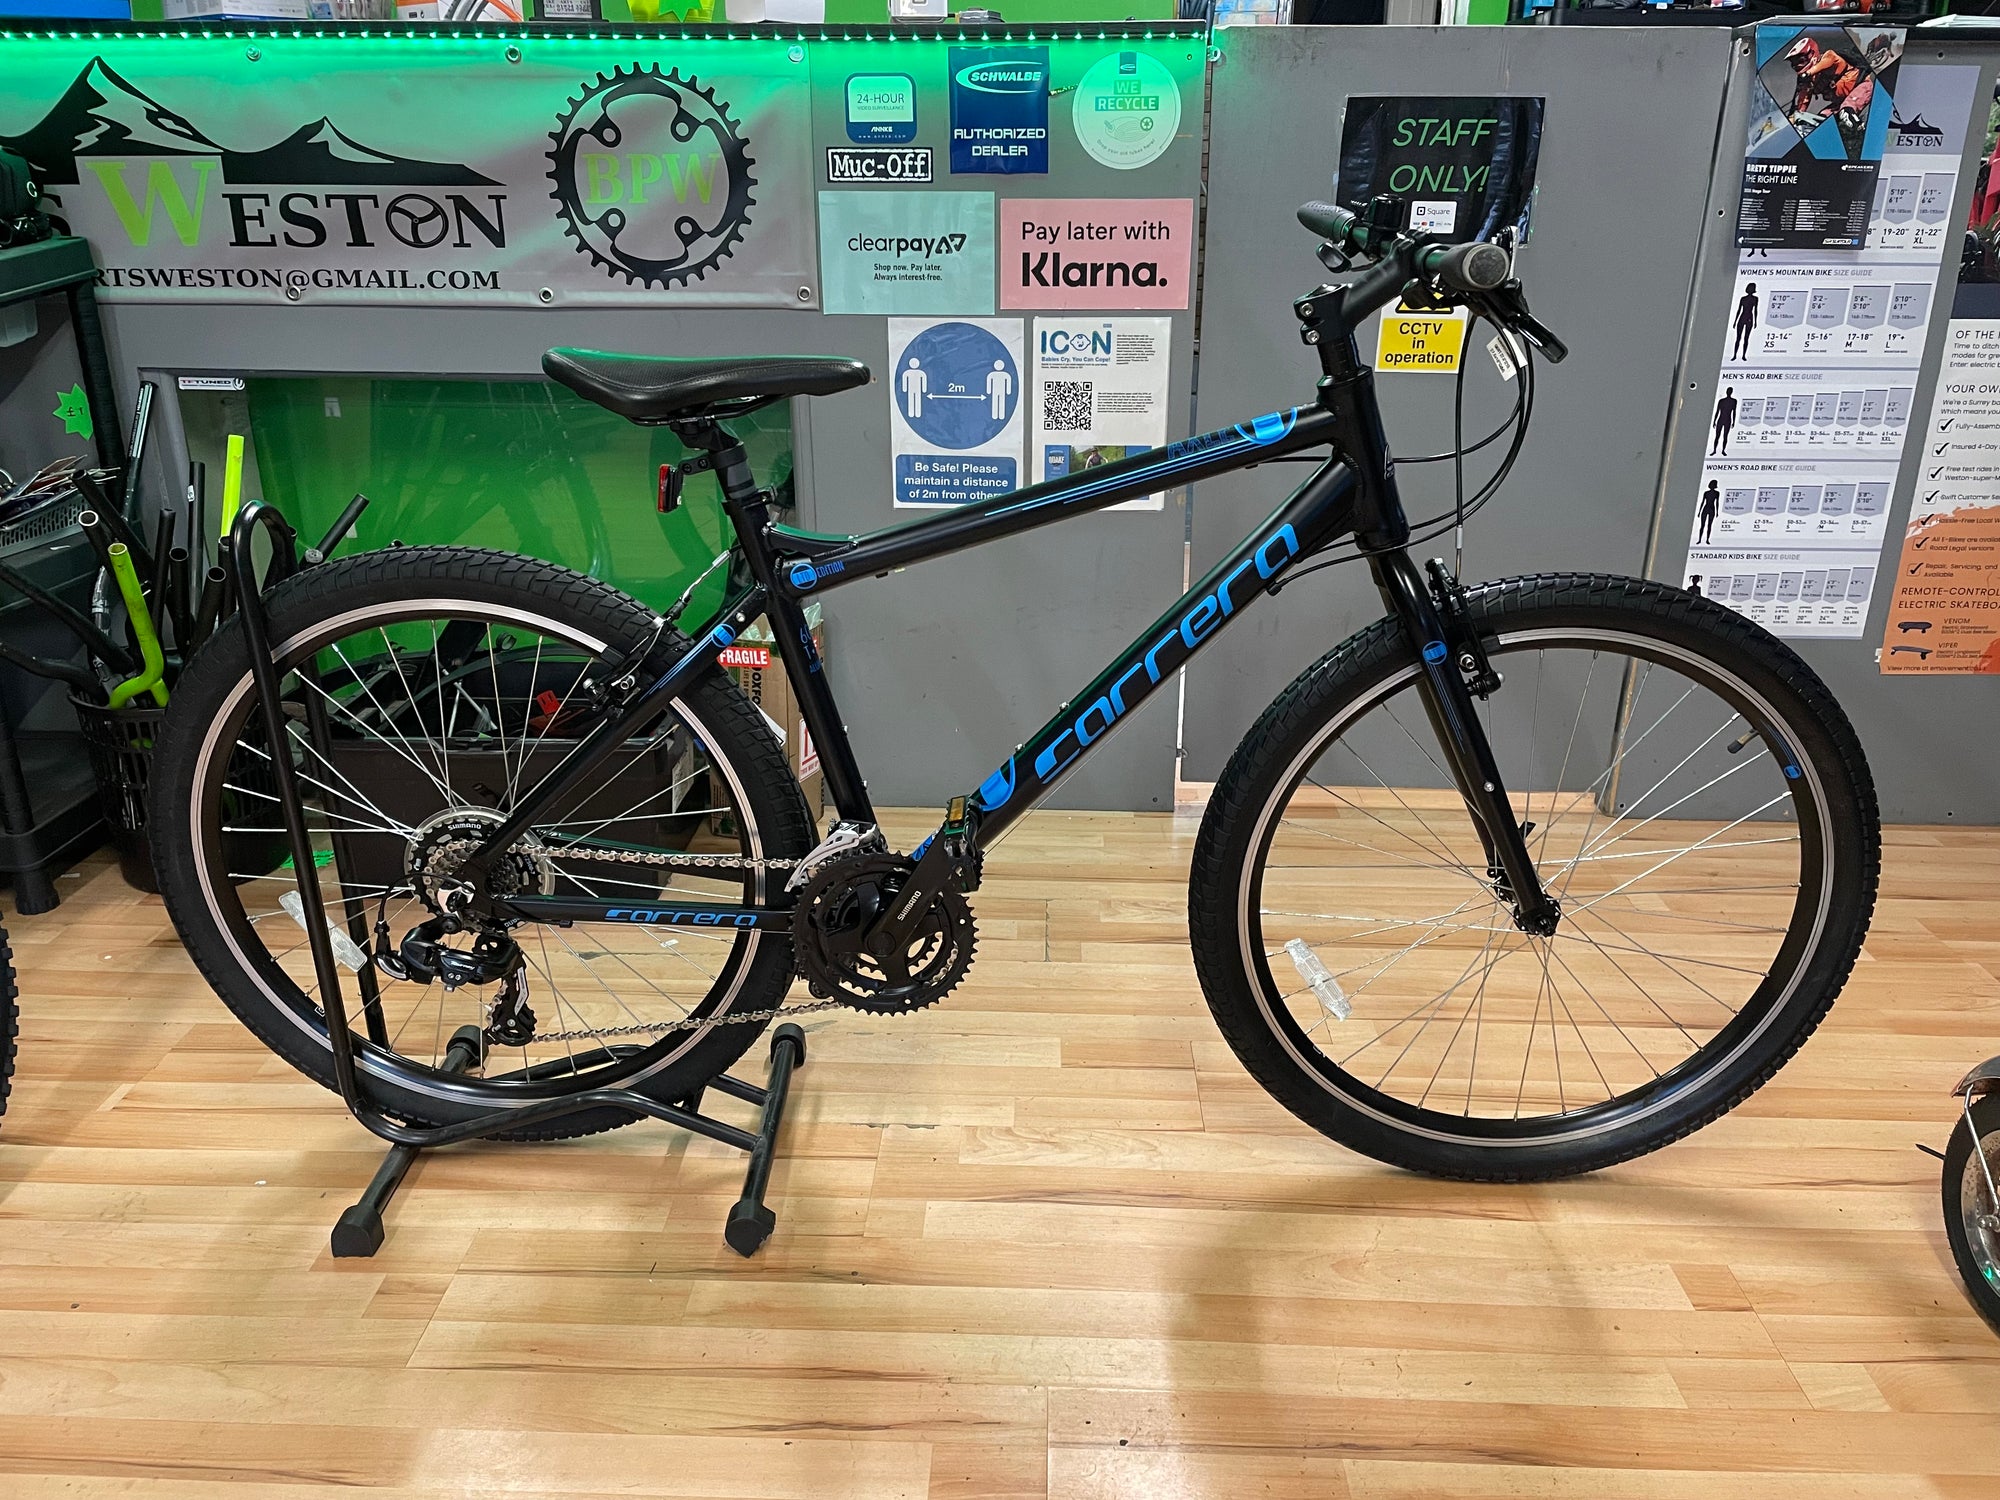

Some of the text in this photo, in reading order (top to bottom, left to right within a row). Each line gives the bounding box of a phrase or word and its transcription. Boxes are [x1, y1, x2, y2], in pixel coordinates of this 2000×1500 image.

[970, 71, 1042, 82] SCHWALBE
[1116, 81, 1139, 94] WE
[857, 93, 905, 104] 24-HOUR
[1097, 97, 1156, 110] RECYCLE
[953, 128, 1046, 139] AUTHORIZED
[1392, 118, 1498, 147] STAFF
[971, 145, 1028, 156] DEALER
[833, 153, 927, 177] Muc-Off
[1746, 164, 1797, 173] BRETT TIPPIE
[581, 153, 722, 205] BPW
[1389, 164, 1490, 193] ONLY!
[1745, 175, 1798, 184] THE RIGHT LINE
[85, 161, 507, 249] WESTON
[1427, 208, 1451, 216] Square
[1022, 220, 1170, 245] Pay later with
[847, 232, 935, 259] clearpay
[873, 263, 891, 272] Shop
[910, 263, 923, 272] Pay
[924, 263, 943, 271] later.
[1022, 252, 1168, 287] Klarna.
[1740, 268, 1774, 276] WOMEN'S
[1850, 269, 1873, 277] GUIDE
[873, 273, 897, 282] Always
[1399, 322, 1443, 335] CCTV
[1955, 330, 1995, 339] OF THE
[1412, 337, 1425, 349] in
[1384, 352, 1453, 365] operation
[948, 382, 965, 393] 2m
[1945, 384, 2000, 394] YOUR OW
[1968, 399, 1990, 407] Surrey
[1977, 443, 1998, 451] 4-Day
[915, 462, 998, 474] Be Safe! Please
[1760, 464, 1777, 472] BIKE
[1778, 464, 1794, 472] SIZE
[904, 476, 1009, 488] maintain a distance
[908, 488, 920, 499] of
[922, 489, 939, 499] 2m
[942, 489, 965, 499] from
[816, 560, 846, 578] EDITION
[1950, 563, 1982, 571] Servicing
[1898, 600, 1946, 609] ELECTRIC
[720, 648, 768, 665] FRAGILE
[1034, 523, 1299, 784] carrera
[897, 890, 922, 921] SHIMANO
[604, 909, 758, 926] carrera
